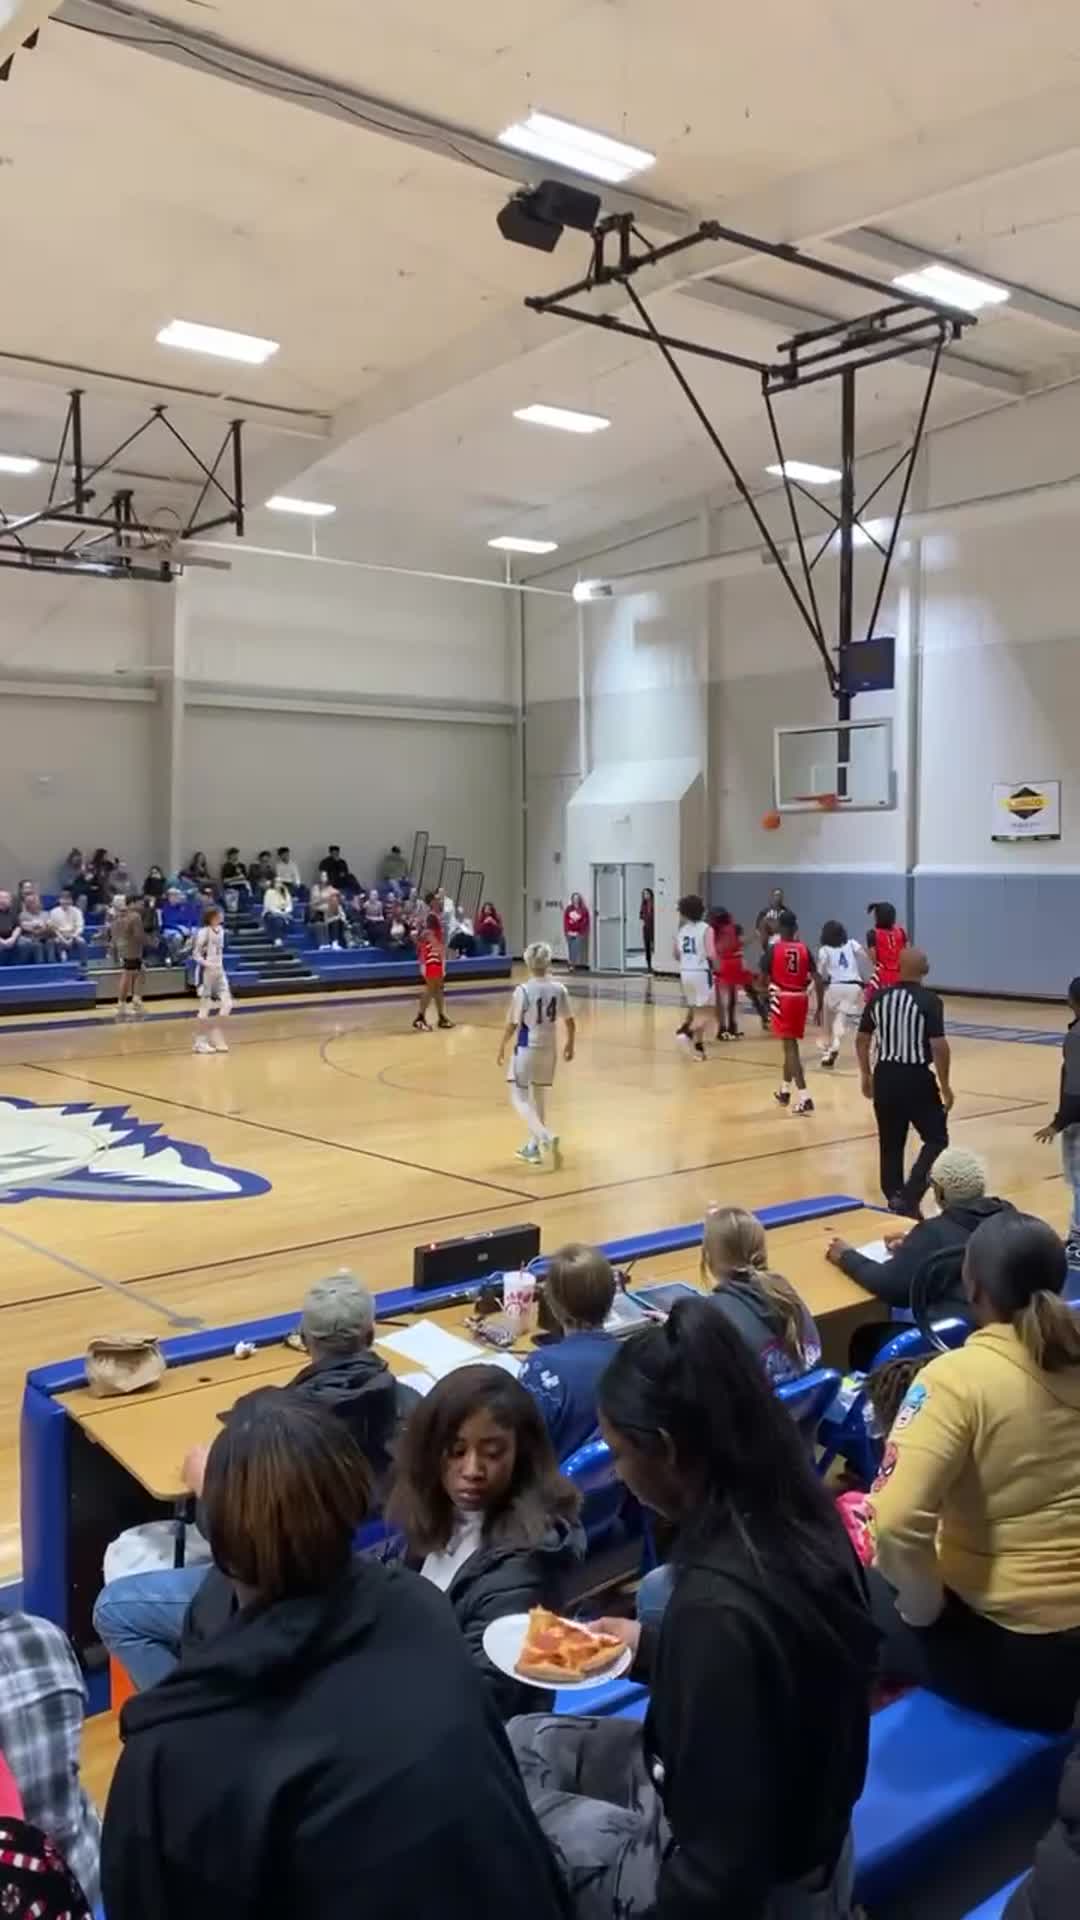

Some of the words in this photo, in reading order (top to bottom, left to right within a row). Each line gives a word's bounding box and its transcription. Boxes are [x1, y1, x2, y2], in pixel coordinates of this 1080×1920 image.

[682, 936, 697, 954] 21
[785, 949, 799, 975] 3
[838, 951, 849, 969] 4
[536, 995, 557, 1024] 14
